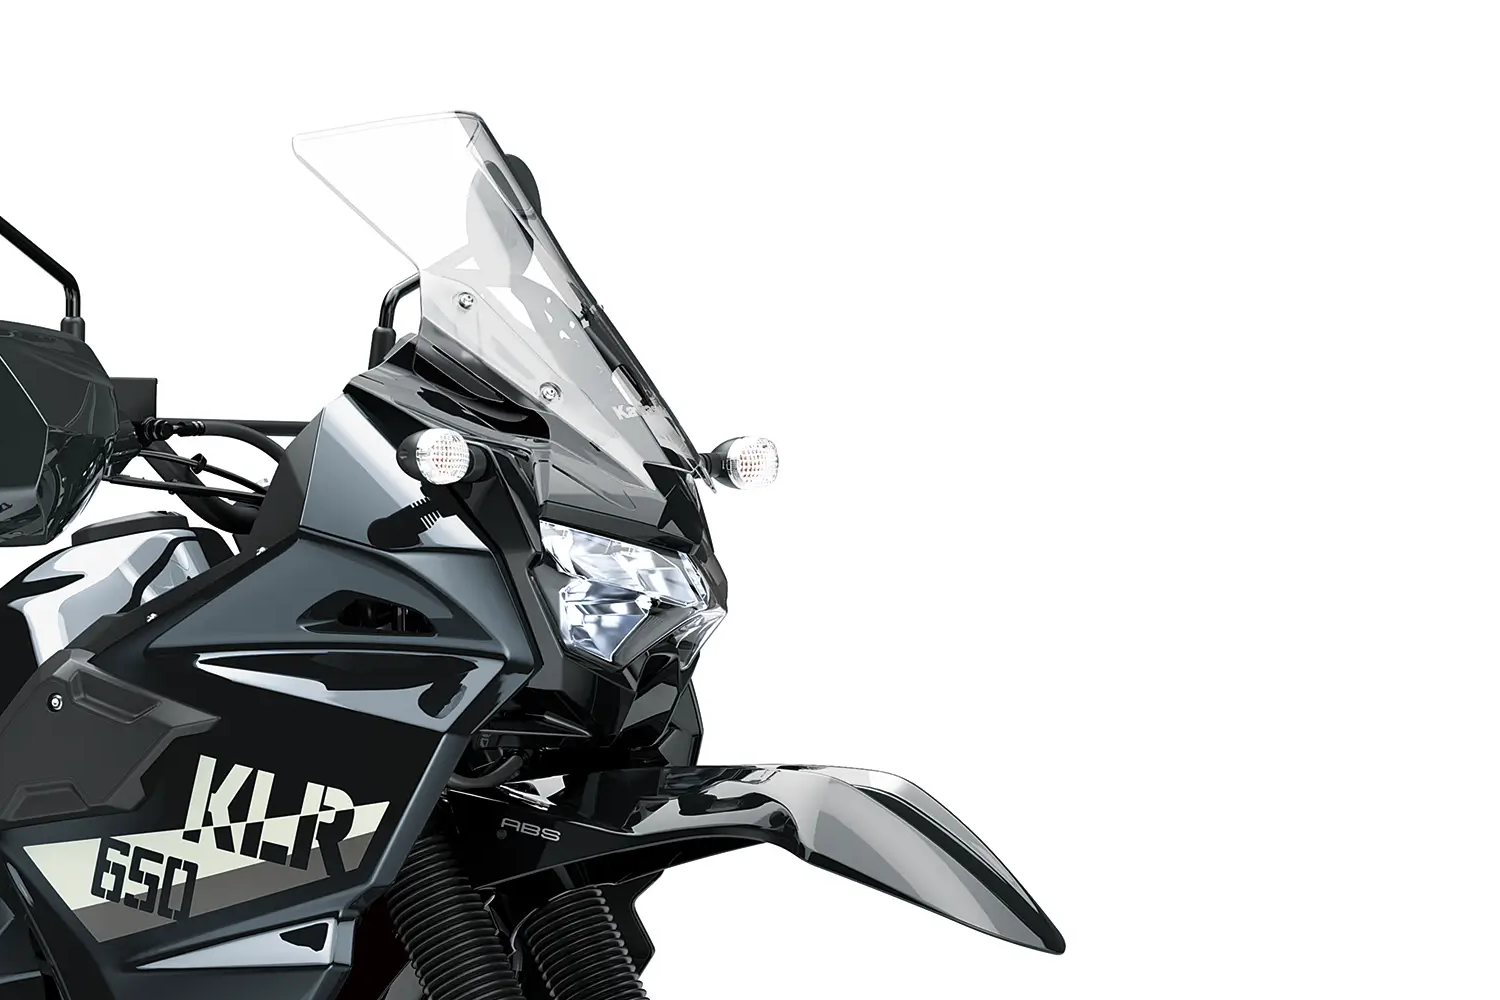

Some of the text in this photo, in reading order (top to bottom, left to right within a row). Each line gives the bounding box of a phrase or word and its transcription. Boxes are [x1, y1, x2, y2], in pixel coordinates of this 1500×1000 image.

[182, 754, 355, 877] KLR
[501, 818, 562, 842] ABS
[91, 836, 199, 921] 650
